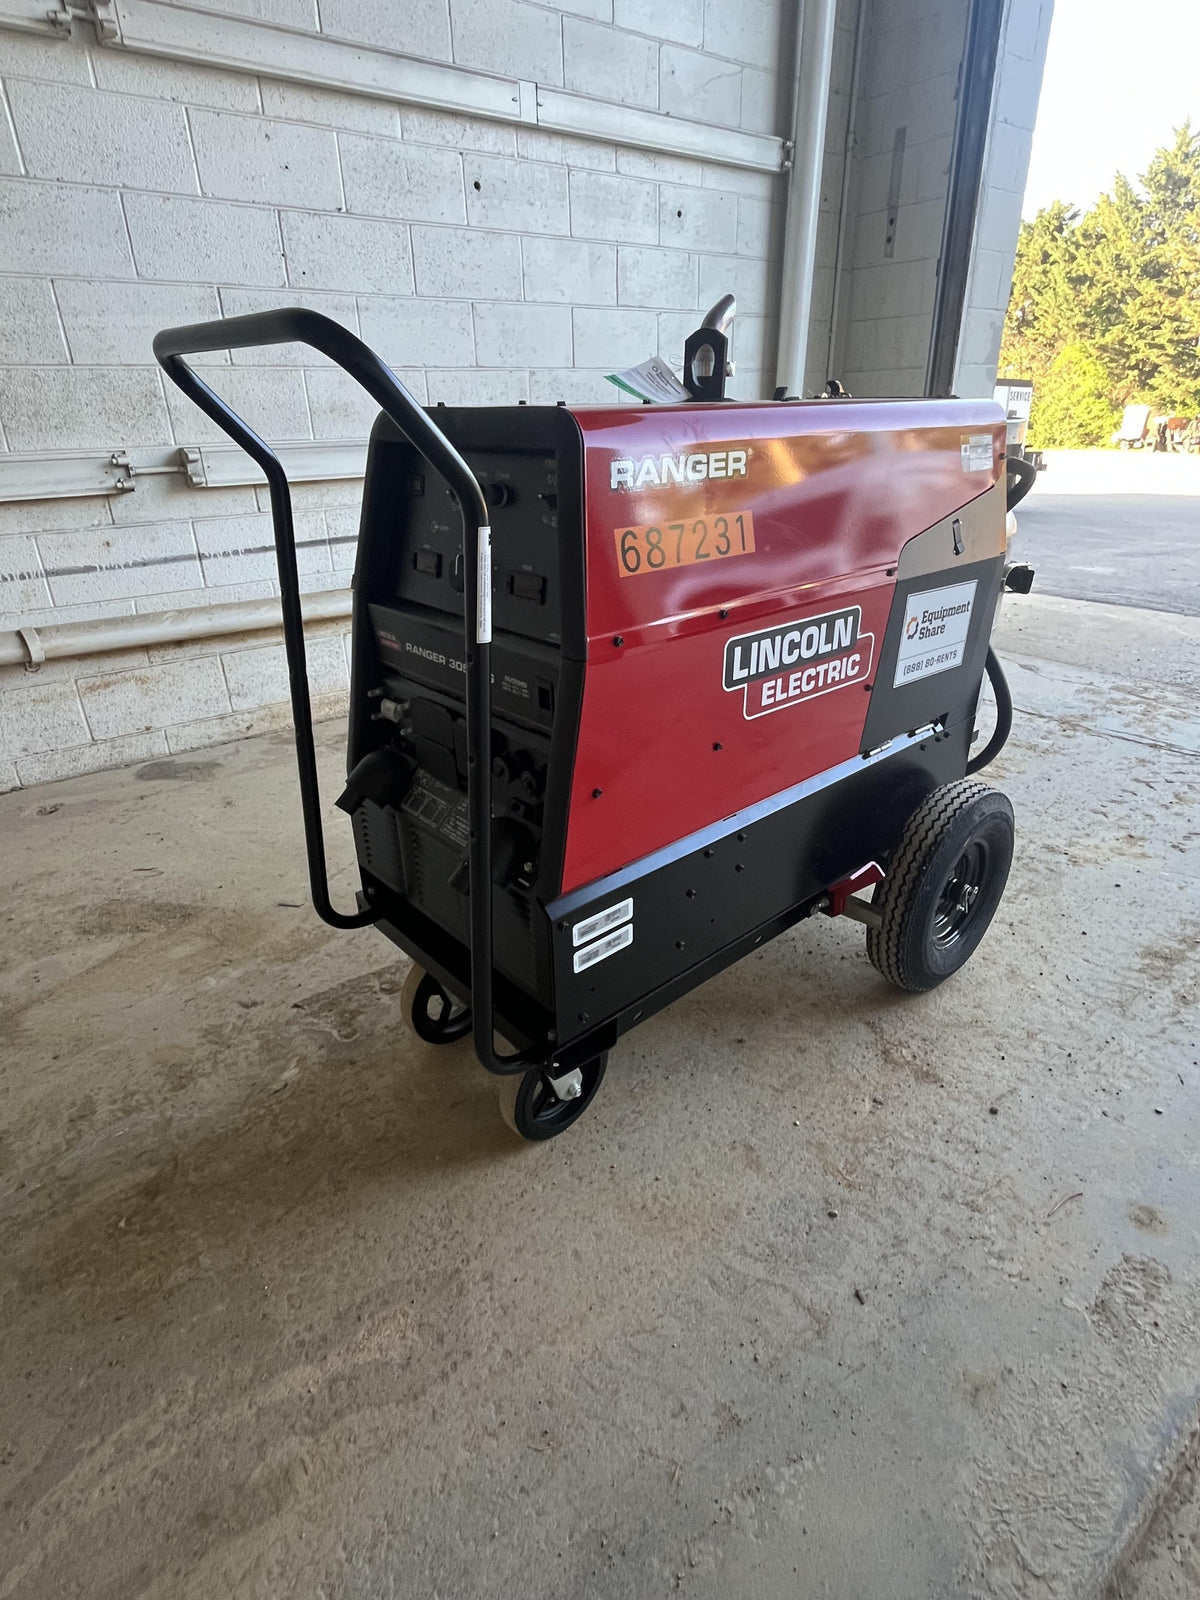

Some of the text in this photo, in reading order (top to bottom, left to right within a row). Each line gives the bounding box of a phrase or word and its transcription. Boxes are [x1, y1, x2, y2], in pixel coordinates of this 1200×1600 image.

[1009, 391, 1031, 402] SERVICE
[610, 450, 747, 490] RANGER
[620, 514, 746, 573] 687231
[921, 600, 971, 625] Equipment
[918, 624, 946, 640] Share
[405, 642, 446, 666] RANGER
[732, 615, 854, 681] LINCOLN
[761, 653, 861, 707] ELECTRIC
[903, 660, 924, 676] (888)
